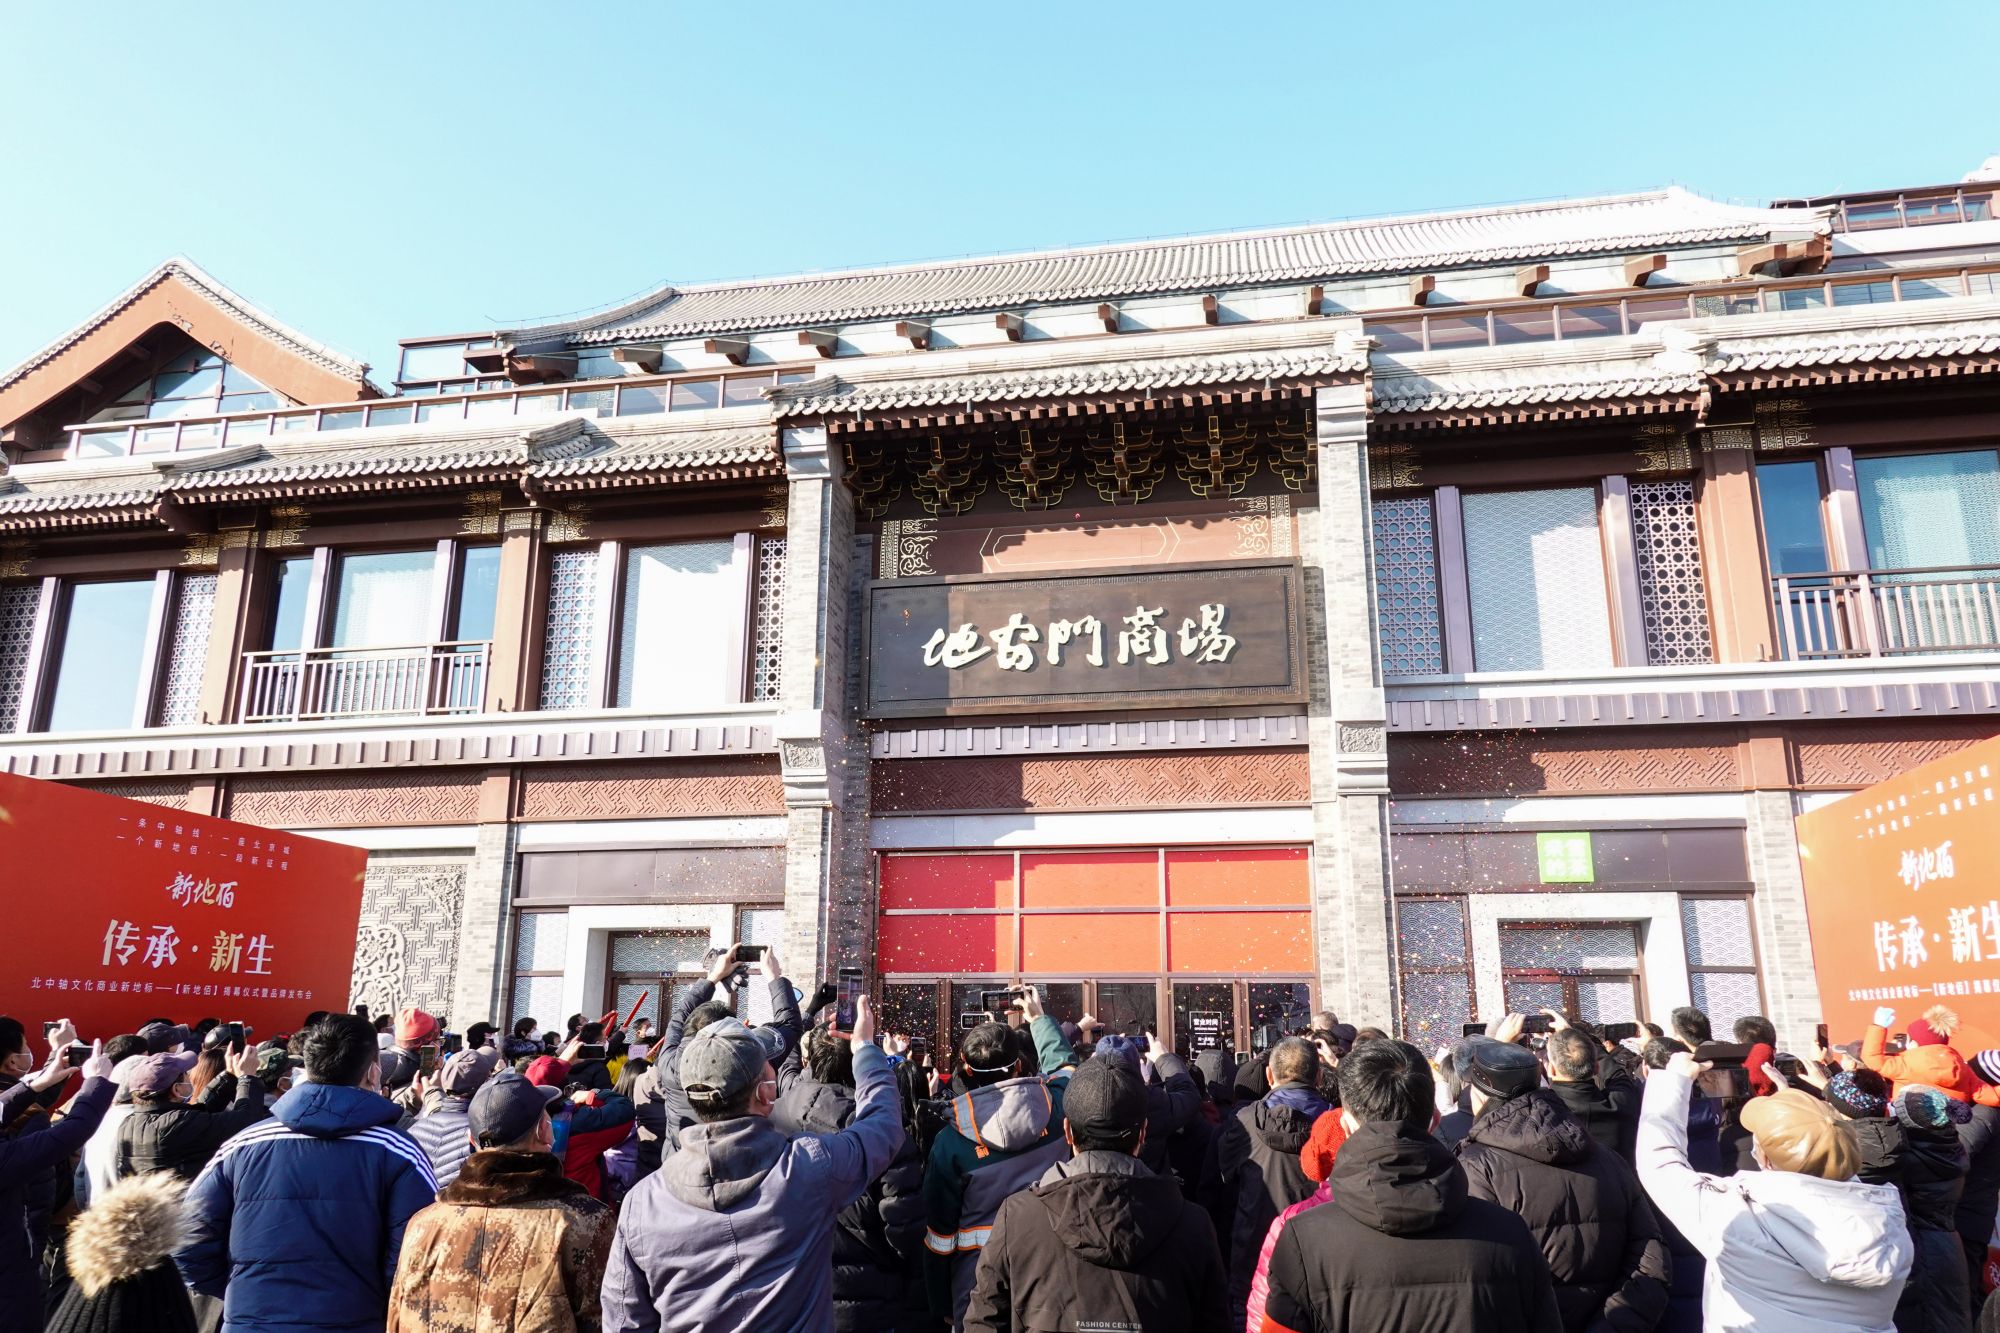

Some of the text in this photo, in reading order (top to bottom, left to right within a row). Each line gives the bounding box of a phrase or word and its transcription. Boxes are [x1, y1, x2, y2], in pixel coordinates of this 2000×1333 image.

[166, 871, 238, 908] 新地佰
[102, 919, 274, 975] 传承·新生
[1111, 1322, 1143, 1330] CENTER
